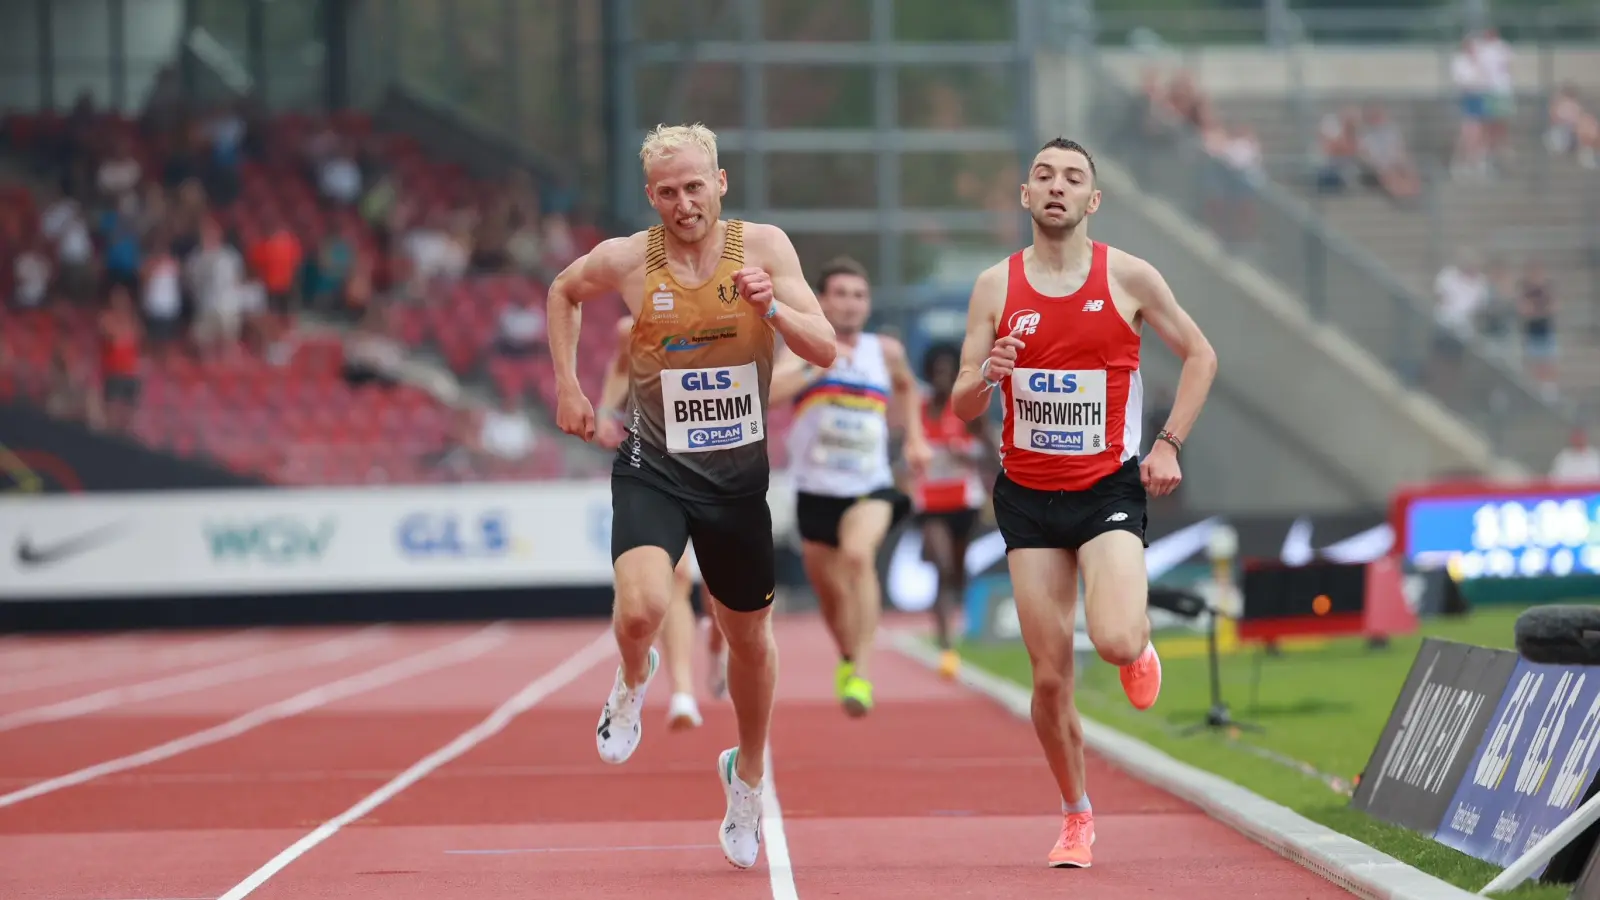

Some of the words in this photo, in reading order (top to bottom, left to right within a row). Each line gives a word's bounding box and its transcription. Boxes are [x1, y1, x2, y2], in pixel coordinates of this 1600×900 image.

[674, 394, 752, 422] BREMM
[1015, 398, 1102, 426] THORWIRTH
[710, 427, 740, 440] PLAN
[750, 421, 758, 435] 230
[1051, 434, 1081, 444] PLAN
[1092, 434, 1100, 448] 498
